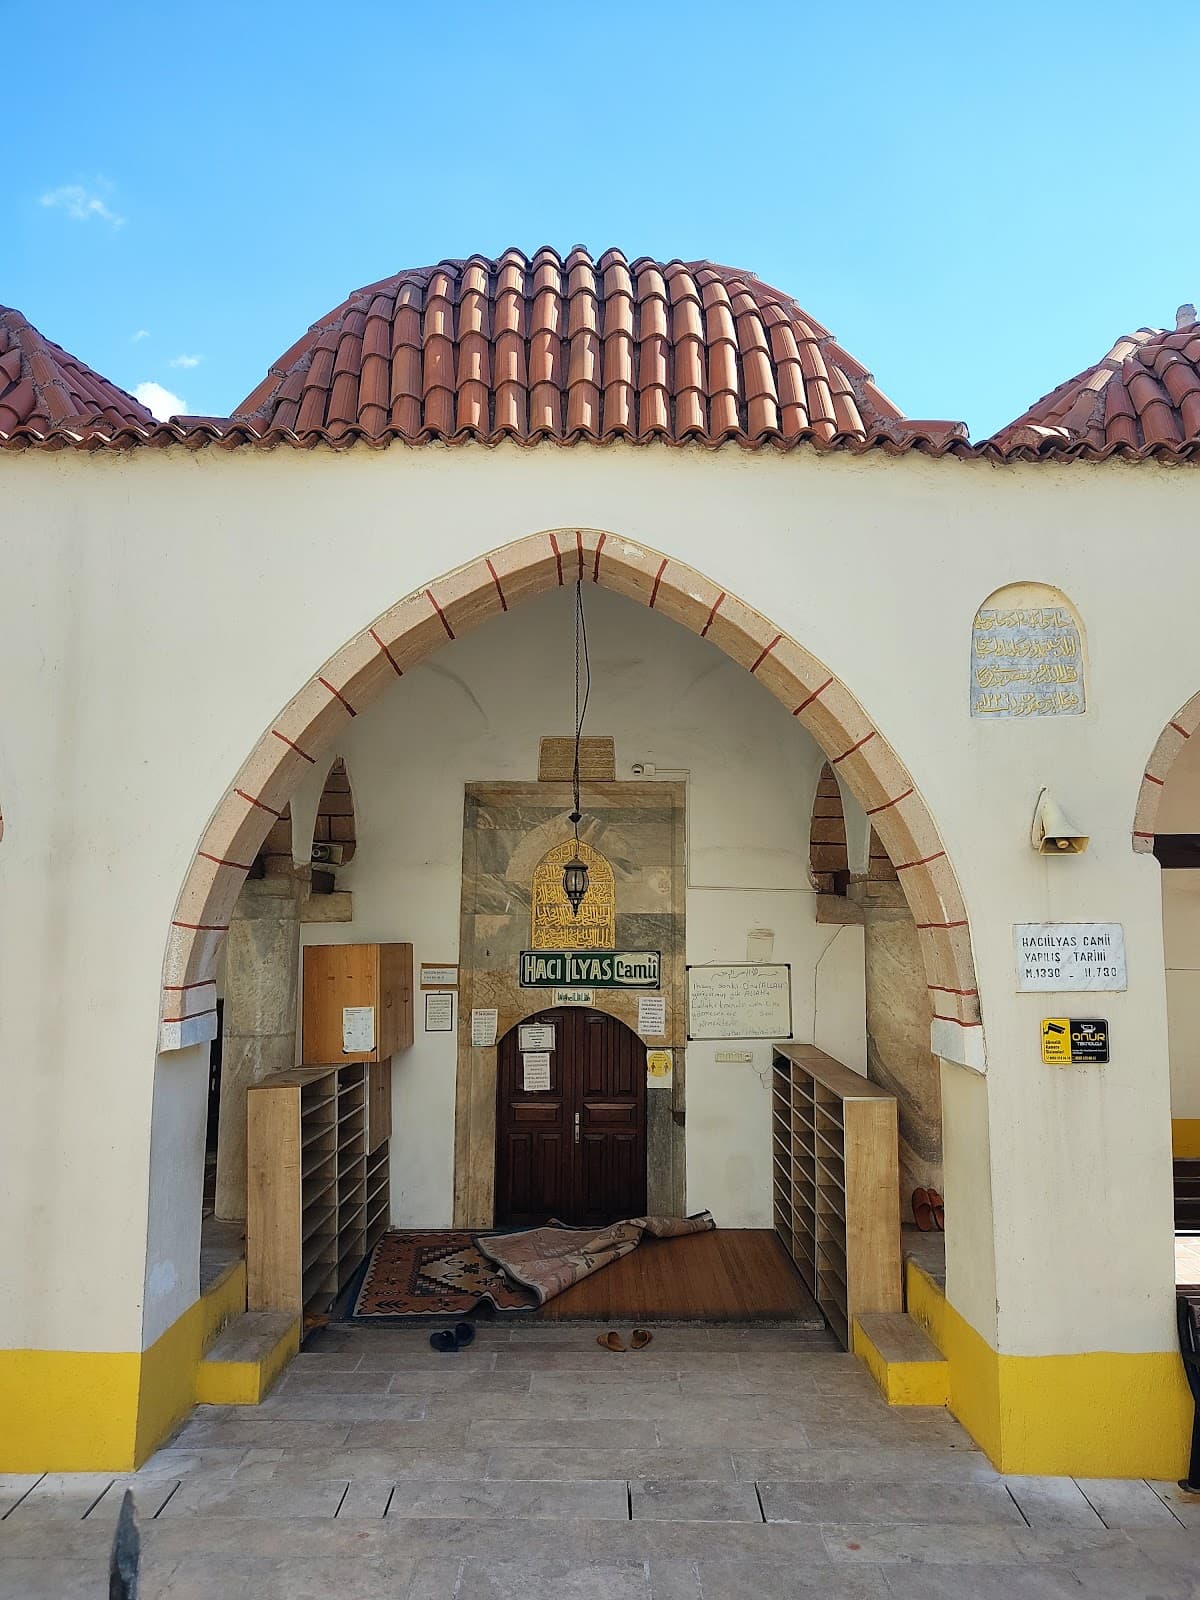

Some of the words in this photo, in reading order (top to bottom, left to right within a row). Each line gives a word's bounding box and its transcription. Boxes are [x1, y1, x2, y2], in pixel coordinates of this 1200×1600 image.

[1083, 933, 1111, 946] CAMİİ
[524, 955, 561, 983] HACI
[565, 952, 612, 983] İLYAS
[1026, 968, 1061, 978] M.1330
